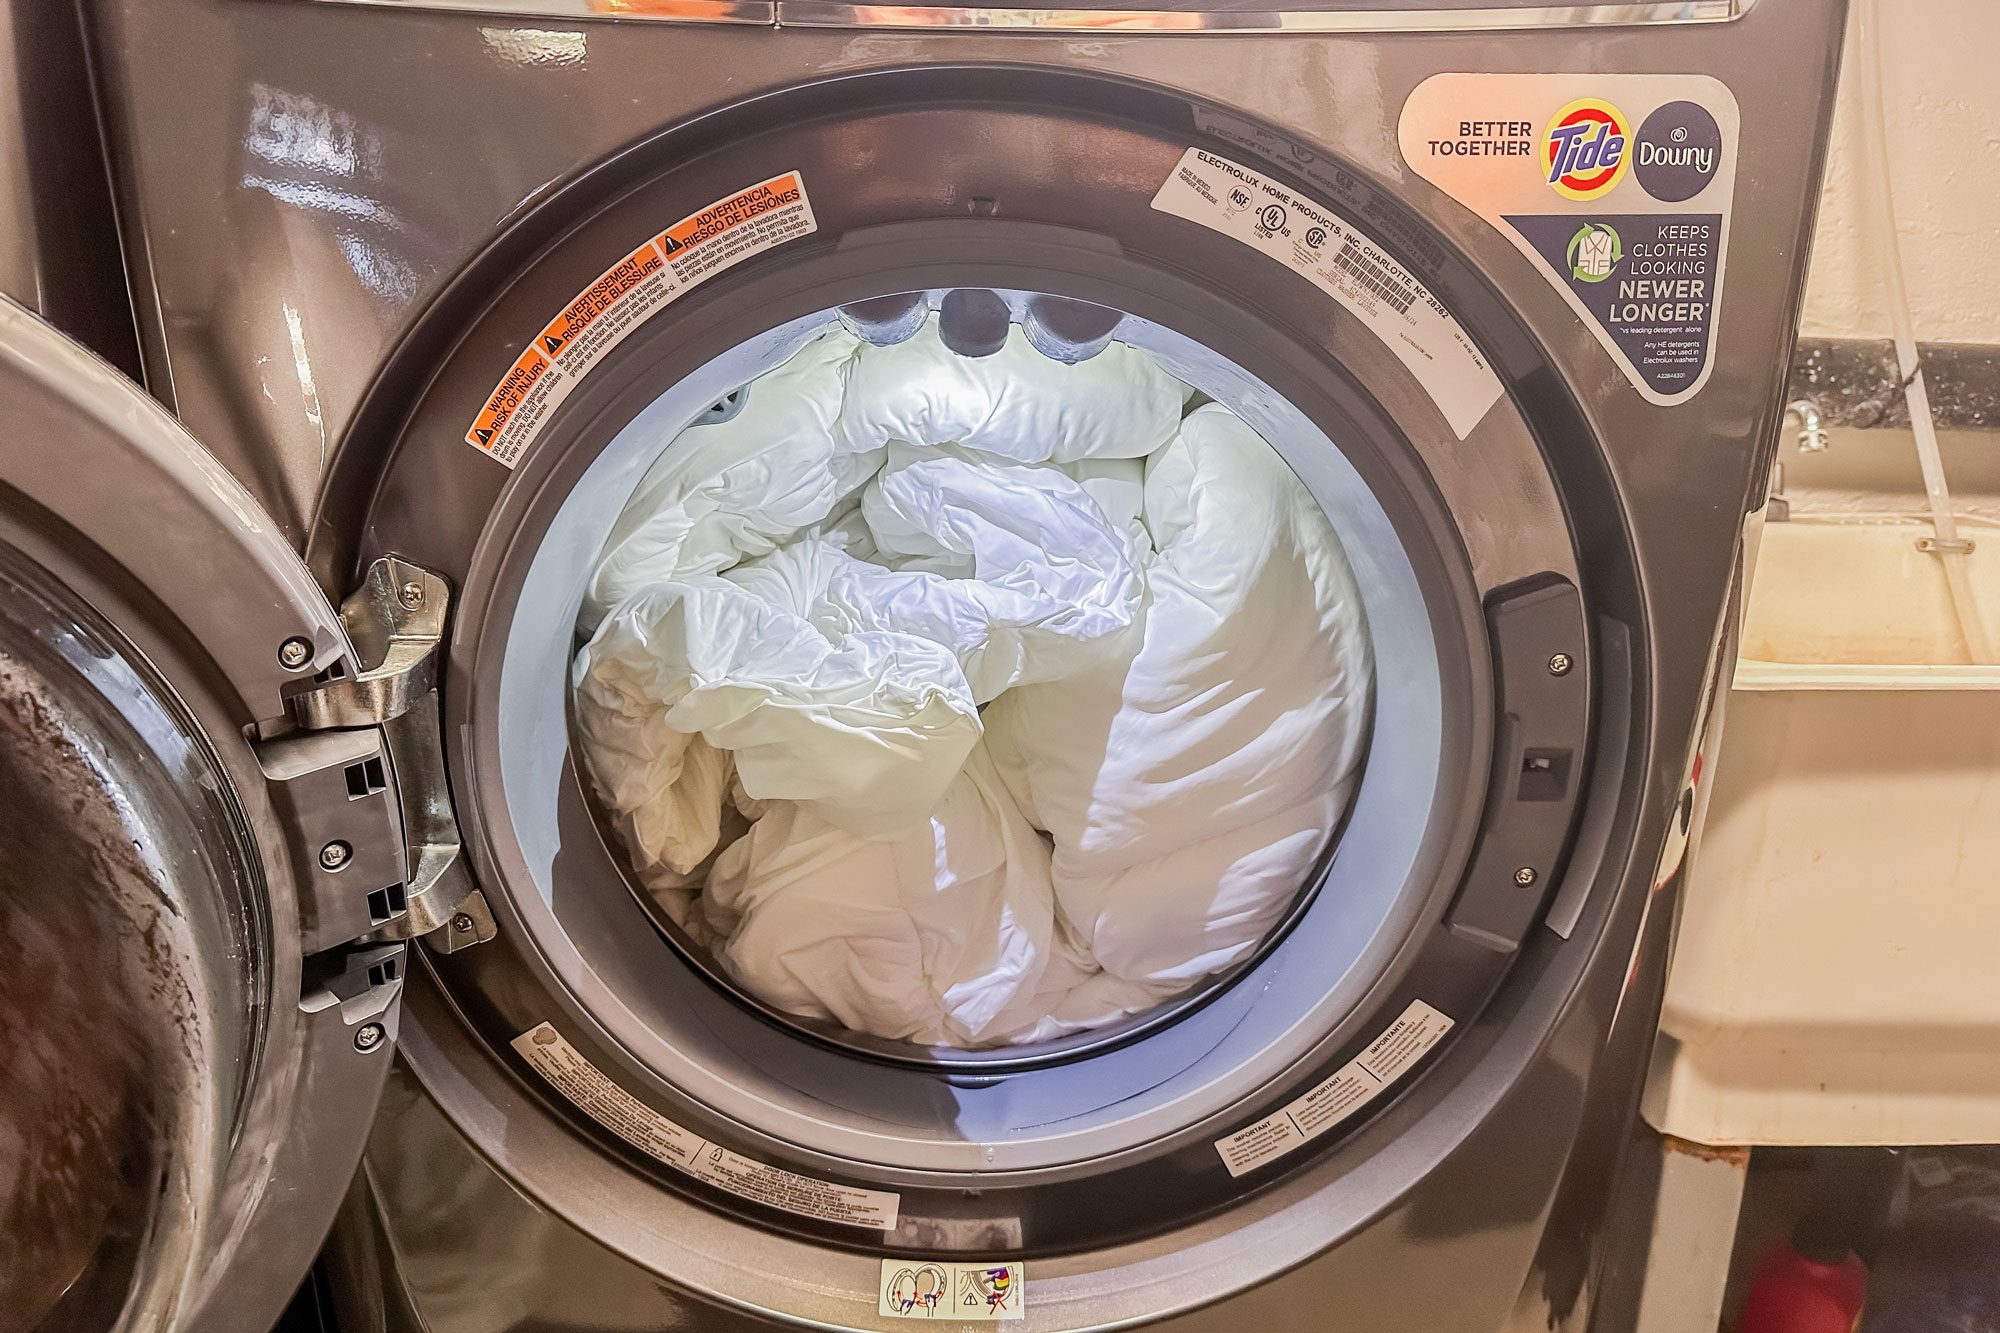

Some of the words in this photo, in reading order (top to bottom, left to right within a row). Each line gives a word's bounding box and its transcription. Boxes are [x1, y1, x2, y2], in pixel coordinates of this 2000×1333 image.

[1459, 122, 1532, 137] BETTER
[1428, 141, 1531, 156] TOGETHER
[1546, 122, 1625, 186] Tide
[1640, 142, 1713, 173] Downy
[1178, 172, 1197, 188] FABRIQUE
[1201, 190, 1218, 205] MEXIQUE
[1181, 166, 1194, 178] MADE
[1196, 178, 1211, 191] MEXICO
[682, 220, 724, 249] RIESGO
[725, 211, 743, 226] DE
[743, 189, 800, 218] LESIONES
[696, 187, 772, 228] ADVERTENCIA
[670, 262, 681, 271] No
[679, 250, 701, 266] coloque
[699, 246, 707, 254] la
[706, 238, 722, 250] mano
[721, 230, 740, 242] dentro
[739, 226, 748, 234] de
[753, 213, 779, 227] lavadora
[778, 204, 804, 217] mientras
[675, 268, 685, 277] las
[684, 259, 702, 273] piezas
[701, 250, 717, 262] están
[716, 246, 725, 254] en
[756, 227, 766, 235] No
[766, 218, 788, 232] permita
[788, 214, 800, 223] que
[1197, 151, 1259, 187] ELECTROLUX
[1262, 184, 1290, 204] HOME
[1291, 200, 1341, 237] PRODUCTS,
[1344, 233, 1360, 250] INC.
[1363, 247, 1413, 288] CHARLOTTE,
[1413, 285, 1427, 298] NC
[1426, 297, 1449, 319] 28262
[1254, 223, 1273, 239] LISTED
[1280, 226, 1291, 238] US
[1658, 226, 1709, 239] KEEPS
[679, 275, 690, 284] los
[702, 255, 725, 272] jueguen
[724, 245, 745, 259] encima
[750, 234, 769, 246] dentro
[1633, 244, 1707, 257] CLOTHES
[594, 294, 611, 311] DE
[609, 257, 662, 299] BLESSURE
[1631, 261, 1705, 275] LOOKING
[565, 258, 637, 323] AVERTISSEMENT
[1619, 280, 1704, 298] NEWER
[556, 358, 566, 367] Ne
[563, 341, 581, 361] plongez
[579, 333, 590, 345] pas
[592, 318, 605, 331] main
[628, 292, 637, 301] de
[640, 275, 661, 292] laveuse
[659, 271, 666, 279] si
[575, 349, 585, 359] est
[582, 343, 590, 352] en
[605, 320, 615, 329] Ne
[628, 300, 640, 311] pas
[637, 294, 648, 303] les
[569, 358, 586, 378] grimper
[584, 351, 593, 361] sur
[591, 346, 599, 354] la
[595, 331, 615, 349] laveuse
[613, 326, 621, 334] ou
[618, 316, 632, 330] jouer
[649, 297, 658, 305] de
[1644, 341, 1656, 349] Any
[488, 367, 525, 412] WARNING
[490, 406, 511, 432] RISK
[506, 392, 519, 408] OF
[516, 358, 545, 394] INJURY
[491, 445, 501, 456] DO
[496, 434, 507, 447] NOT
[504, 421, 516, 436] reach
[513, 412, 523, 423] into
[519, 404, 529, 413] the
[525, 382, 545, 405] appliance
[544, 371, 555, 380] the
[499, 445, 511, 459] drum
[521, 412, 531, 423] DO
[527, 402, 538, 415] NOT
[536, 390, 548, 404] allow
[546, 372, 563, 392] children
[509, 445, 520, 458] play
[515, 438, 523, 447] on
[523, 427, 531, 435] in
[527, 420, 536, 429] the
[1370, 1020, 1405, 1054] IMPORTANTE
[1306, 1077, 1341, 1103] IMPORTANT
[630, 1099, 659, 1119] Performance
[1234, 1121, 1271, 1143] IMPORTANT
[763, 1166, 780, 1174] DOOR
[780, 1171, 796, 1179] LOCK
[797, 1176, 829, 1187] OPERATION
[787, 1186, 812, 1196] SERRURE
